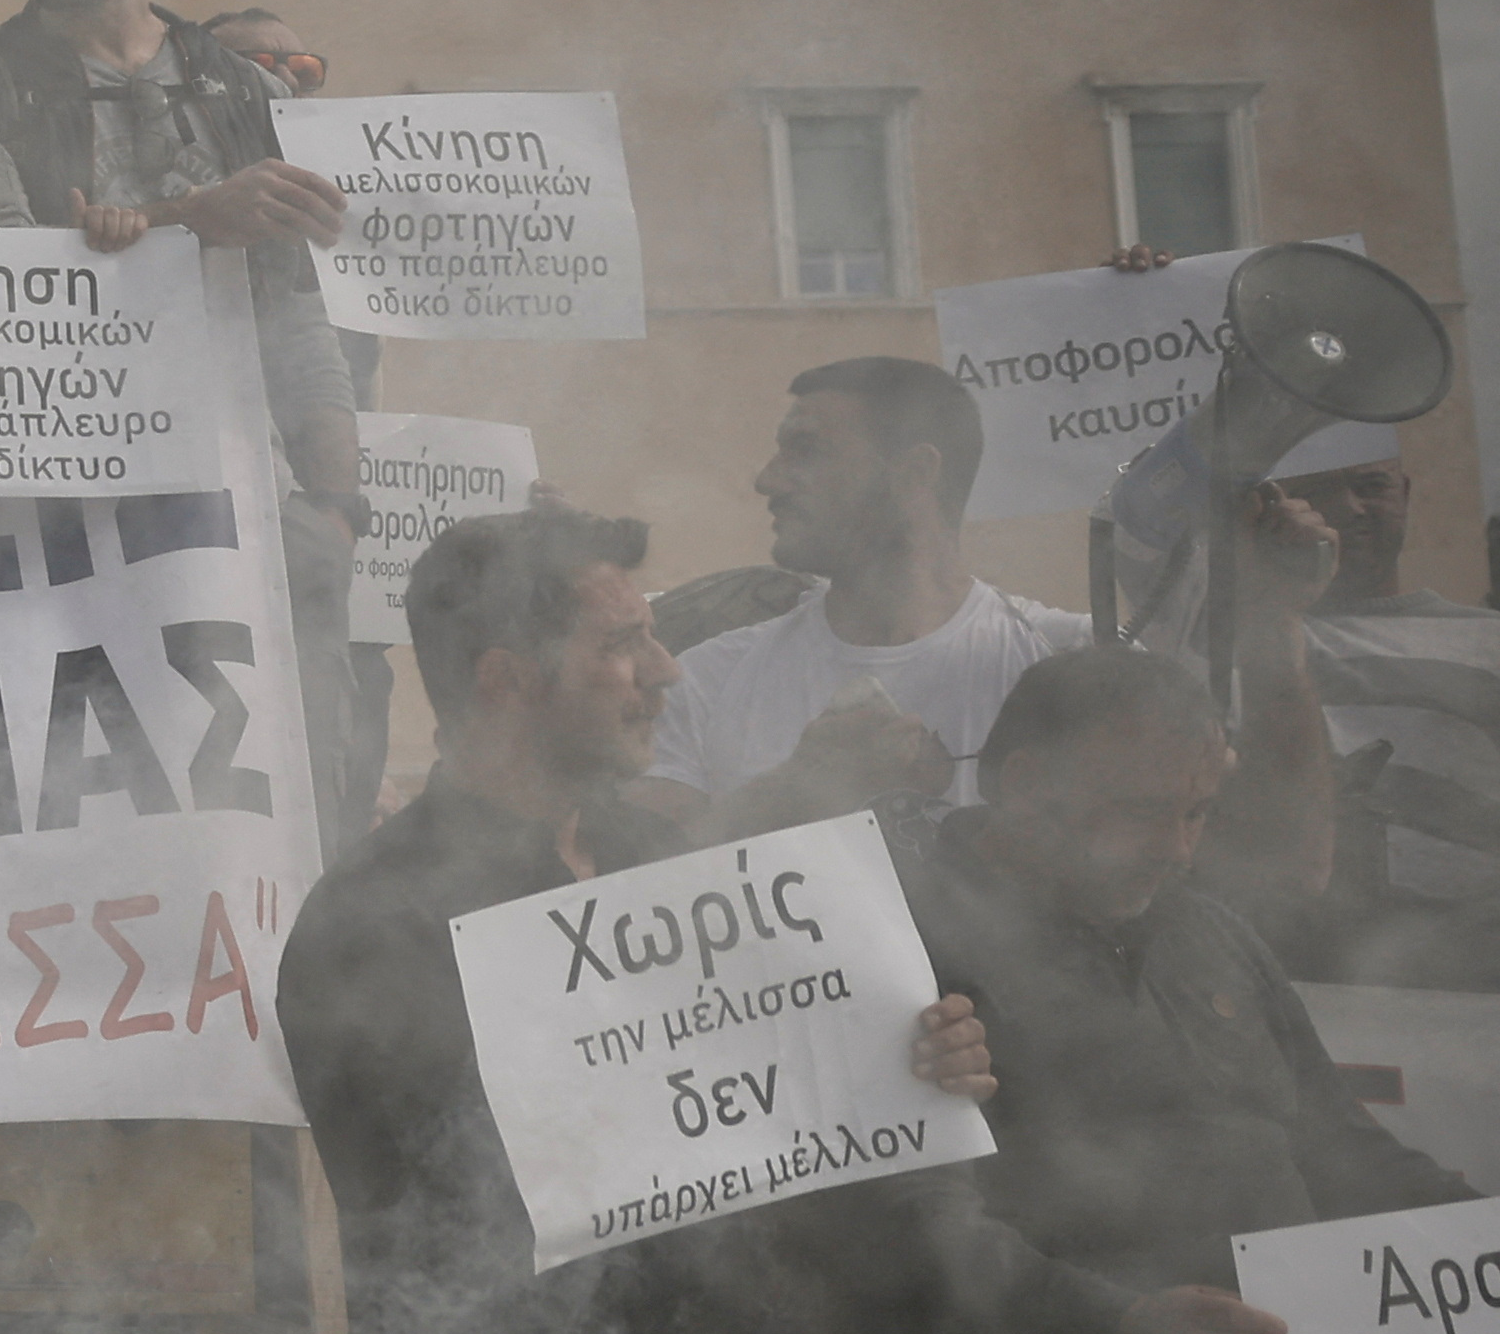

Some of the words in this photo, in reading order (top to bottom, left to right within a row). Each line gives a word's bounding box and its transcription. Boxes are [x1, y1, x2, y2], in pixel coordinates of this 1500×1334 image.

[361, 118, 549, 173] Κίνηση
[334, 165, 592, 203] μελισσοκομικών
[360, 205, 577, 250] φορτηγών
[332, 252, 392, 278] στο
[398, 249, 609, 287] παράπλευρο
[366, 283, 454, 317] οδικό
[462, 283, 575, 321] δίκτυο
[546, 850, 823, 993] Χωρίς
[574, 1014, 649, 1069] την
[662, 961, 852, 1058] μέλισσα
[668, 1061, 781, 1140] δεν
[591, 1164, 756, 1243] υπάρχει
[766, 1117, 929, 1201] μέλλον
